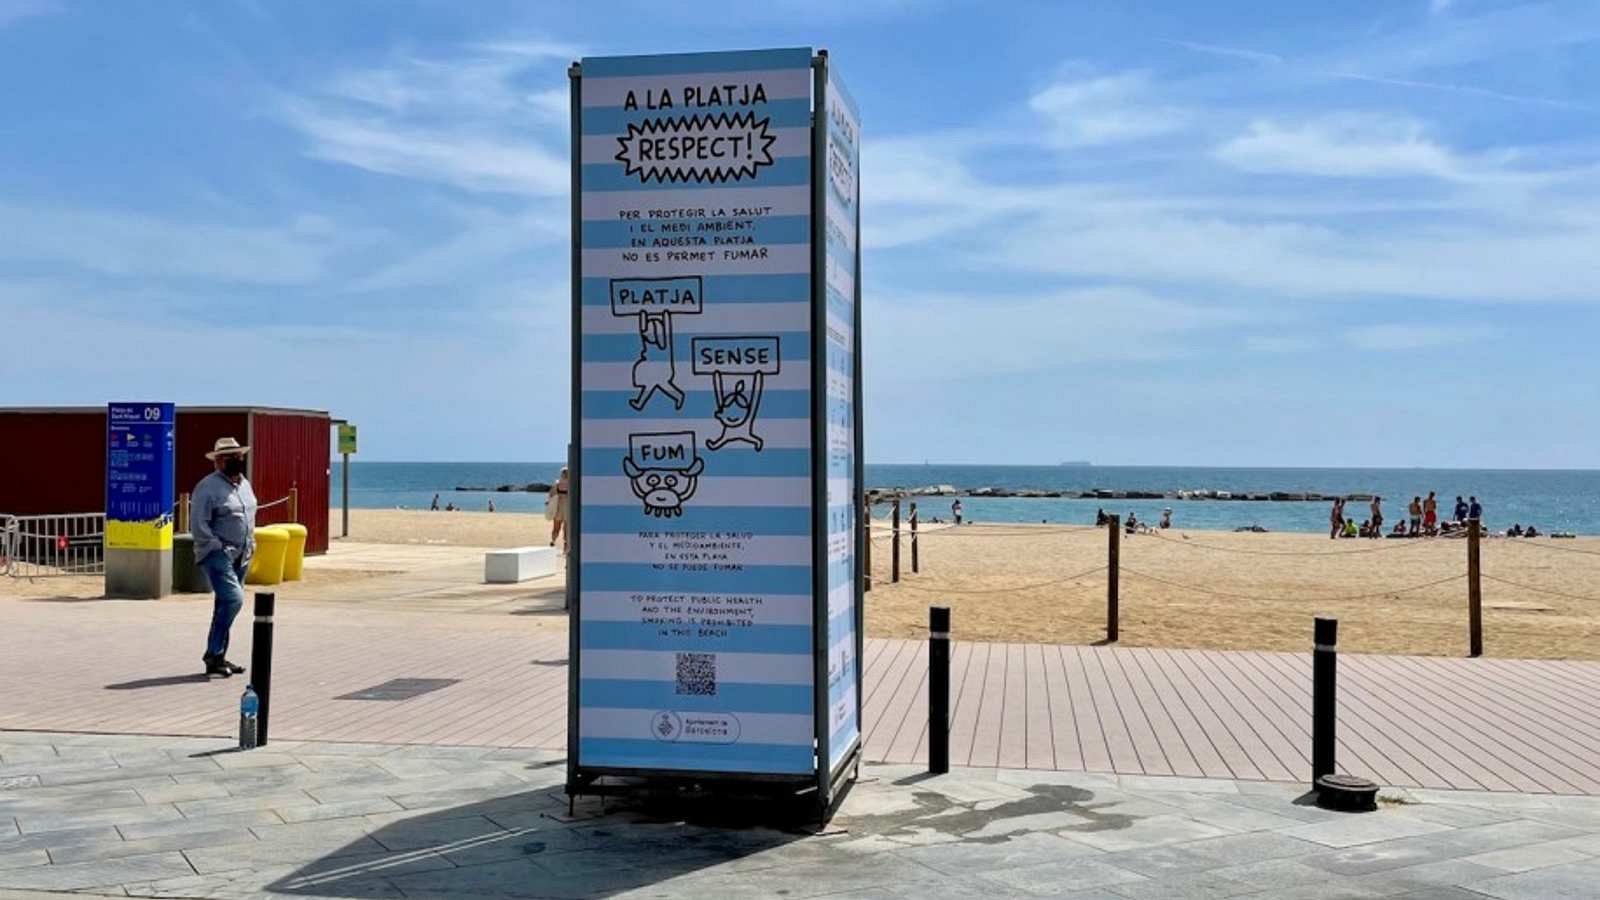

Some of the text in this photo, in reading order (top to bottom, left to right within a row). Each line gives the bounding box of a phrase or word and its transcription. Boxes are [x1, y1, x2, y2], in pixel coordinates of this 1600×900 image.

[624, 83, 767, 111] A LA PLATJA
[638, 132, 753, 161] RESPECT!
[619, 206, 773, 220] PER PROTEGIR LA SALUT
[640, 223, 655, 233] EL
[660, 222, 691, 232] MEDI
[696, 220, 756, 232] AMBIENT,
[631, 235, 754, 248] EN AQUESTA PLATJA
[622, 248, 768, 262] NO ES PERMET FUMAR
[618, 288, 696, 305] PLATJA
[700, 347, 770, 365] SENSE
[144, 407, 161, 420] 09
[641, 444, 685, 461] FUM
[691, 596, 721, 604] PUBLIC
[726, 597, 763, 605] HEALTH
[701, 618, 753, 627] PROHIBITED
[685, 727, 728, 735] Barcelona
